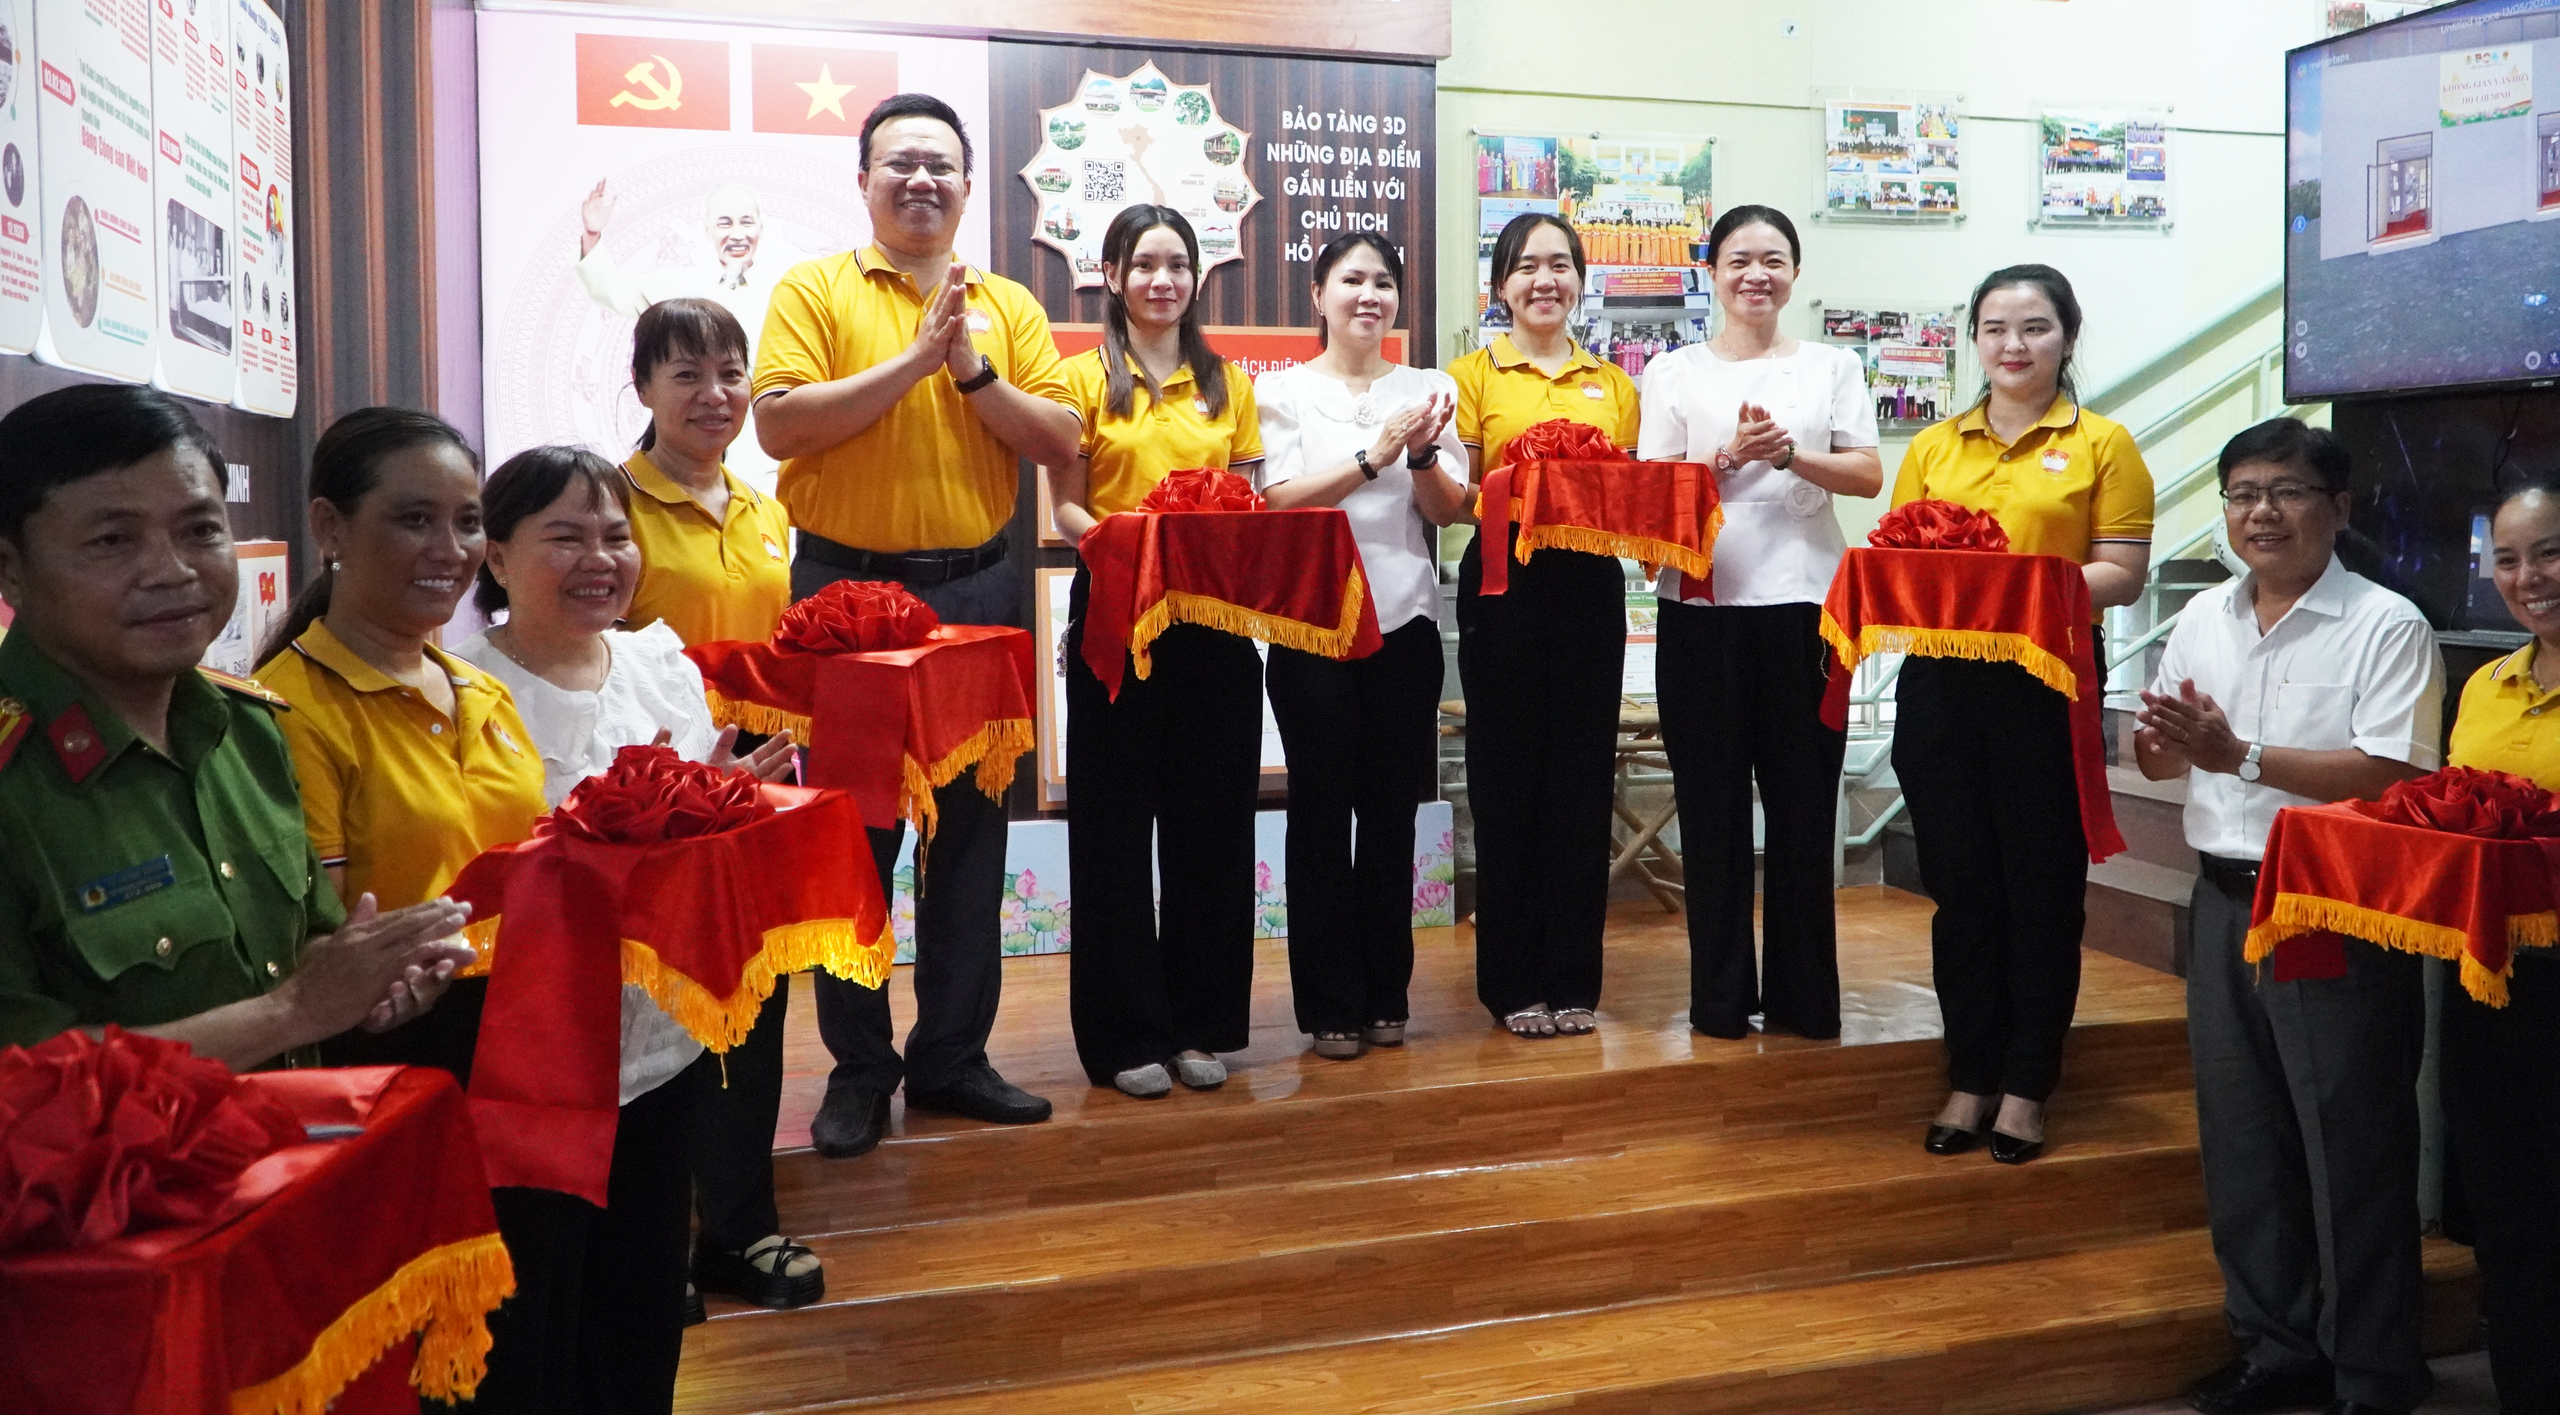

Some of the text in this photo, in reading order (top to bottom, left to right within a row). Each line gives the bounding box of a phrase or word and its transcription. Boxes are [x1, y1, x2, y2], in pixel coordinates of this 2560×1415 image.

[2440, 17, 2473, 34] Untitled
[2473, 12, 2500, 26] space
[1282, 104, 1406, 135] BẢO TÀNG 3D
[1266, 139, 1421, 171] NHỮNG ĐỊA ĐIỂM
[1283, 168, 1405, 200] GẮN LIỀN VỚI
[1301, 205, 1388, 234] CHỦ TỊCH
[1284, 234, 1313, 262] HỒ
[225, 463, 250, 502] MINH
